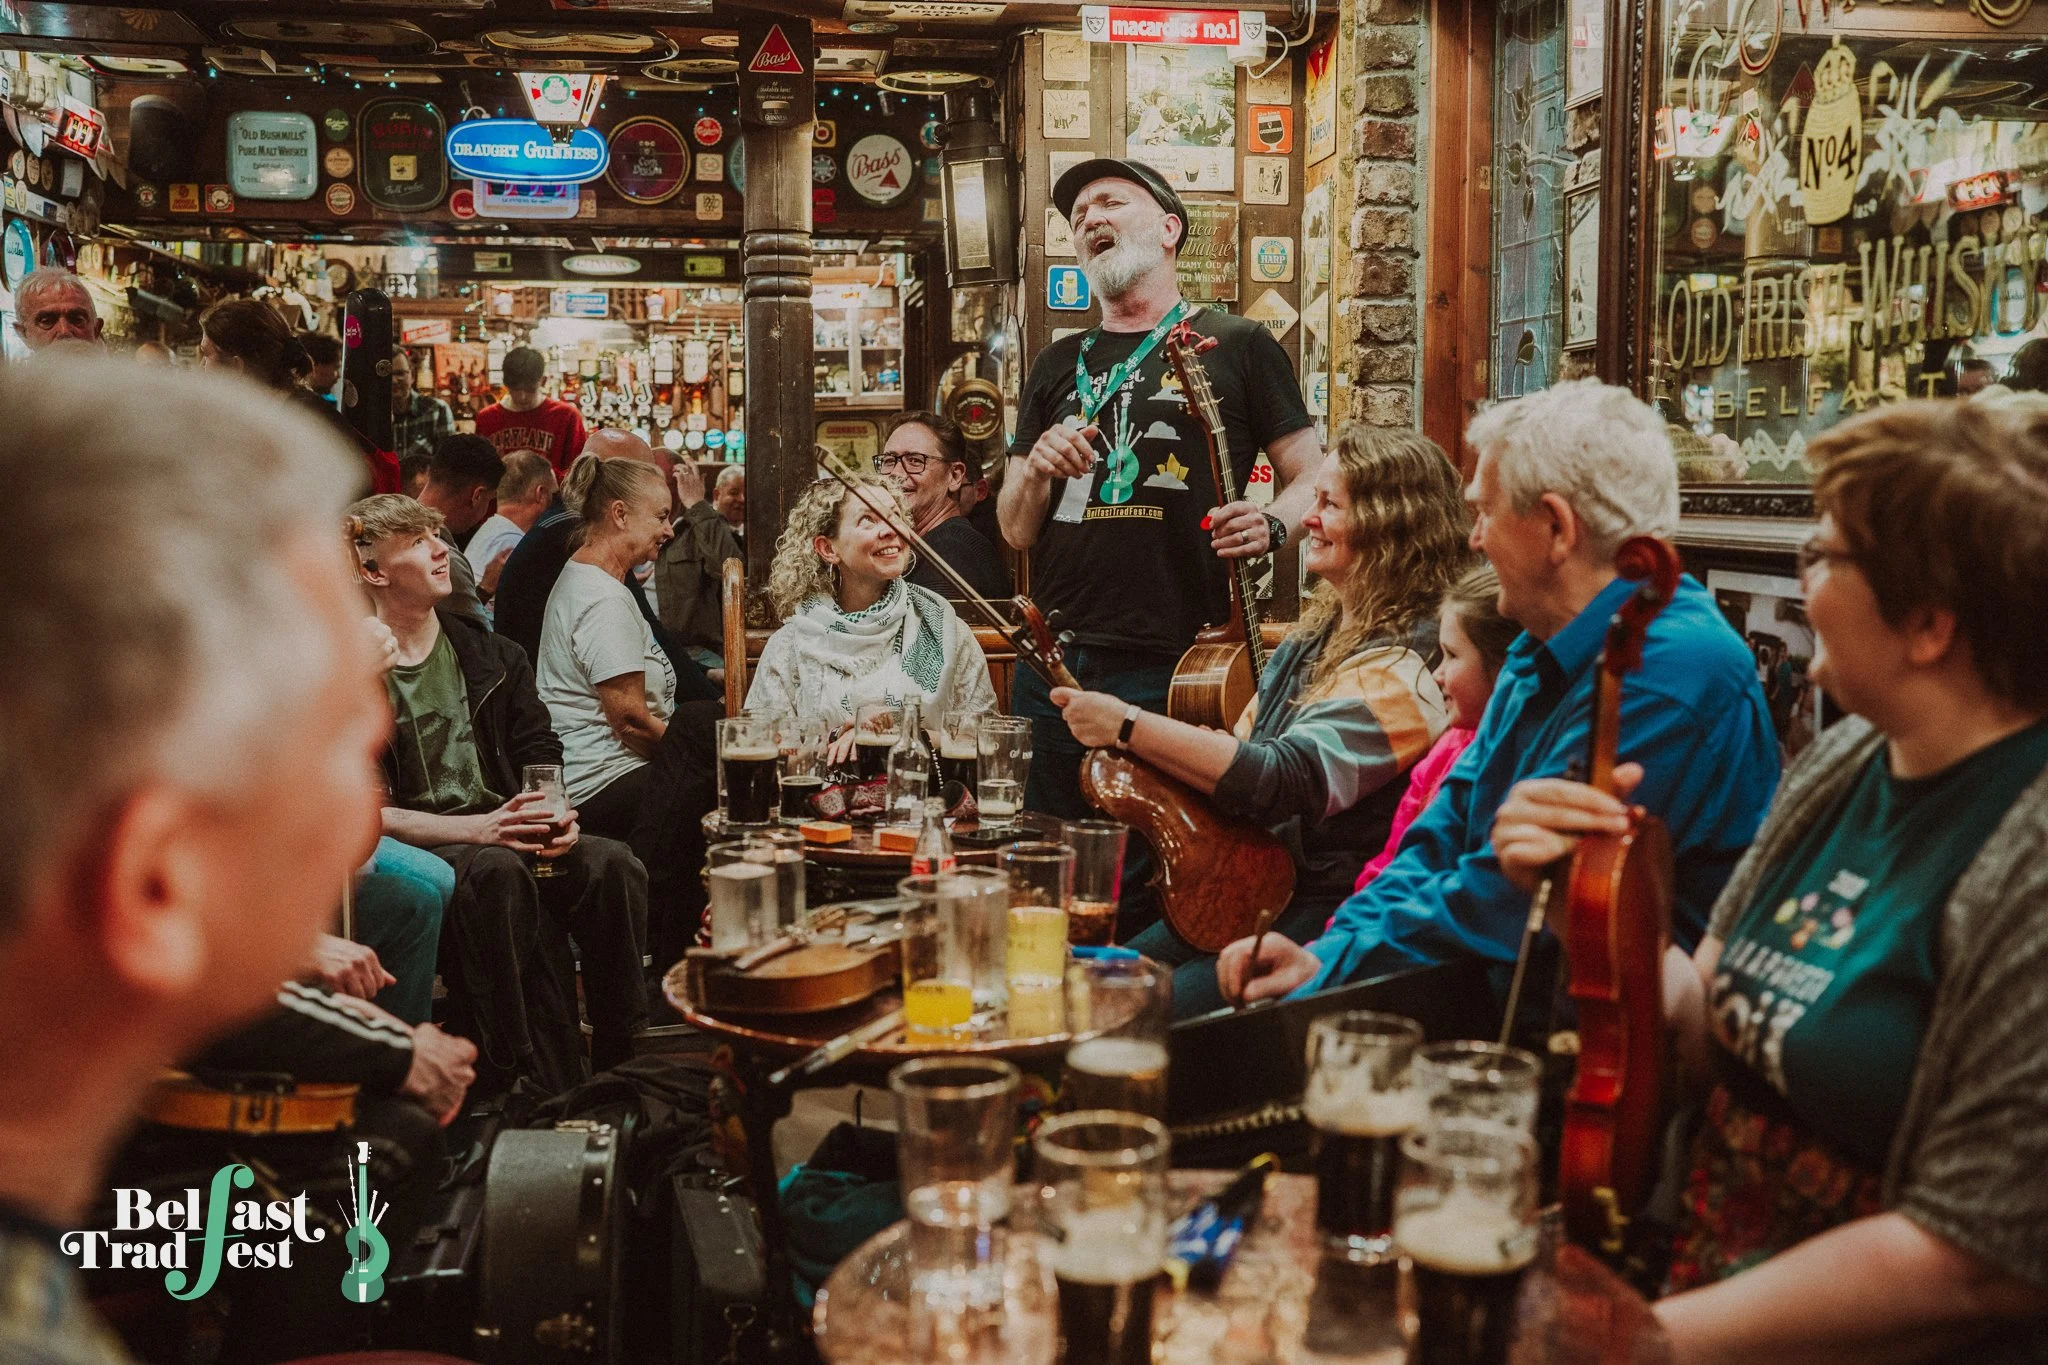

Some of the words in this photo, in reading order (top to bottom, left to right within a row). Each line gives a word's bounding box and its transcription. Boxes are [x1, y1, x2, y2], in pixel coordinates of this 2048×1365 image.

[894, 4, 995, 12] WATNEYS
[1111, 18, 1198, 38] macardles
[757, 51, 791, 68] Bass
[1309, 117, 1332, 155] JAMESON
[454, 143, 519, 158] DRAUGHT
[524, 141, 598, 160] GUINNESS
[851, 147, 902, 180] Bass
[1188, 222, 1221, 236] dear
[1176, 261, 1202, 269] REAMY
[1205, 261, 1222, 269] OLD
[1261, 254, 1286, 264] HARP
[1194, 272, 1228, 283] WHISKY
[1668, 279, 1733, 369] OLD
[1743, 265, 1848, 362] IRISH
[1715, 372, 1948, 419] BELFAST
[489, 427, 554, 453] ARYLAND
